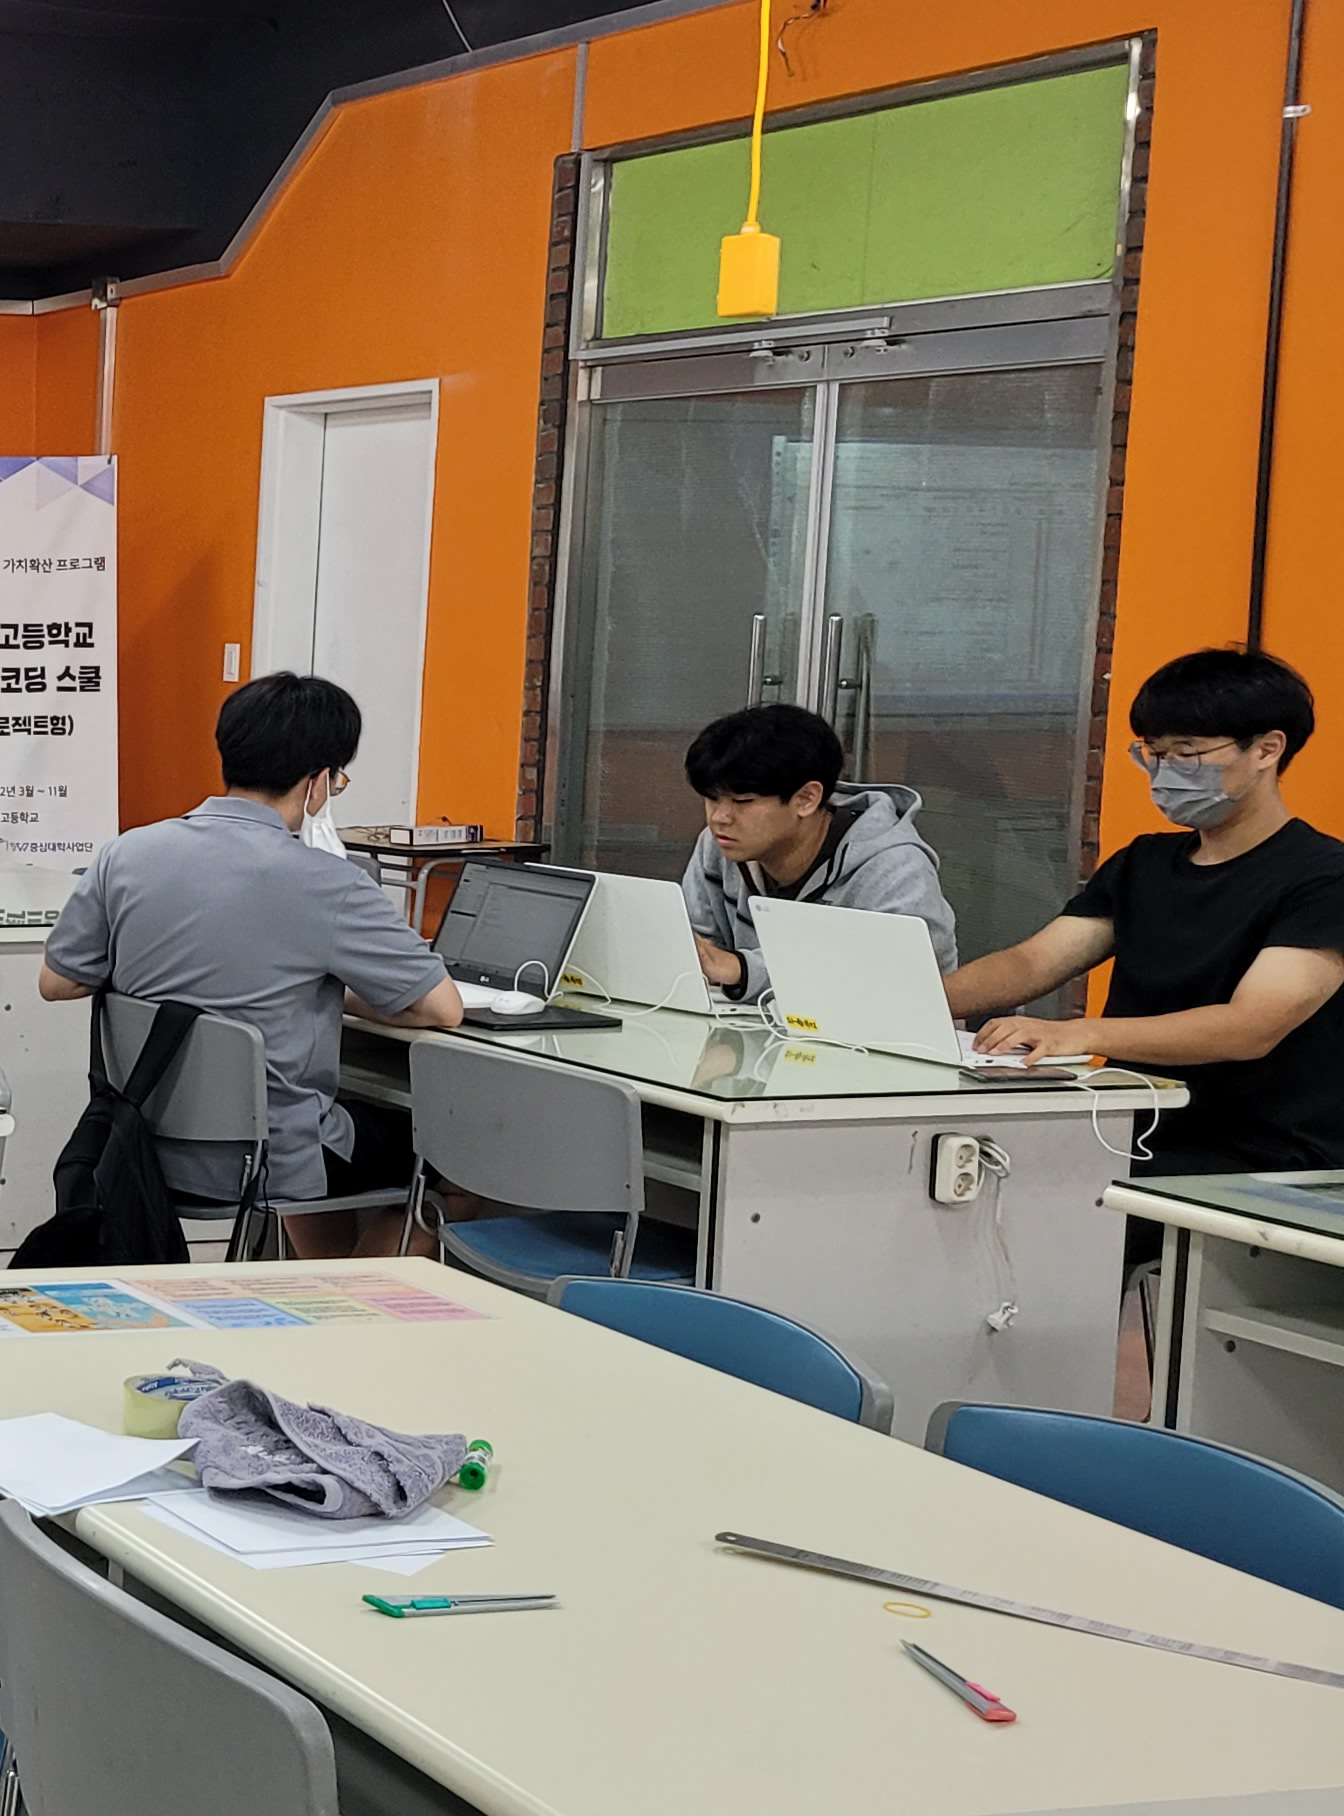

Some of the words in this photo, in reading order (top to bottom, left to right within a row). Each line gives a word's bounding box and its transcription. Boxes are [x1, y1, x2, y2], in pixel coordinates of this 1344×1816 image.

[3, 558, 53, 573] 가치확산
[56, 556, 106, 572] 프로그램
[0, 666, 47, 693] 코딩
[56, 666, 102, 692] 스쿨
[18, 786, 34, 797] 3월
[48, 786, 68, 797] 11월
